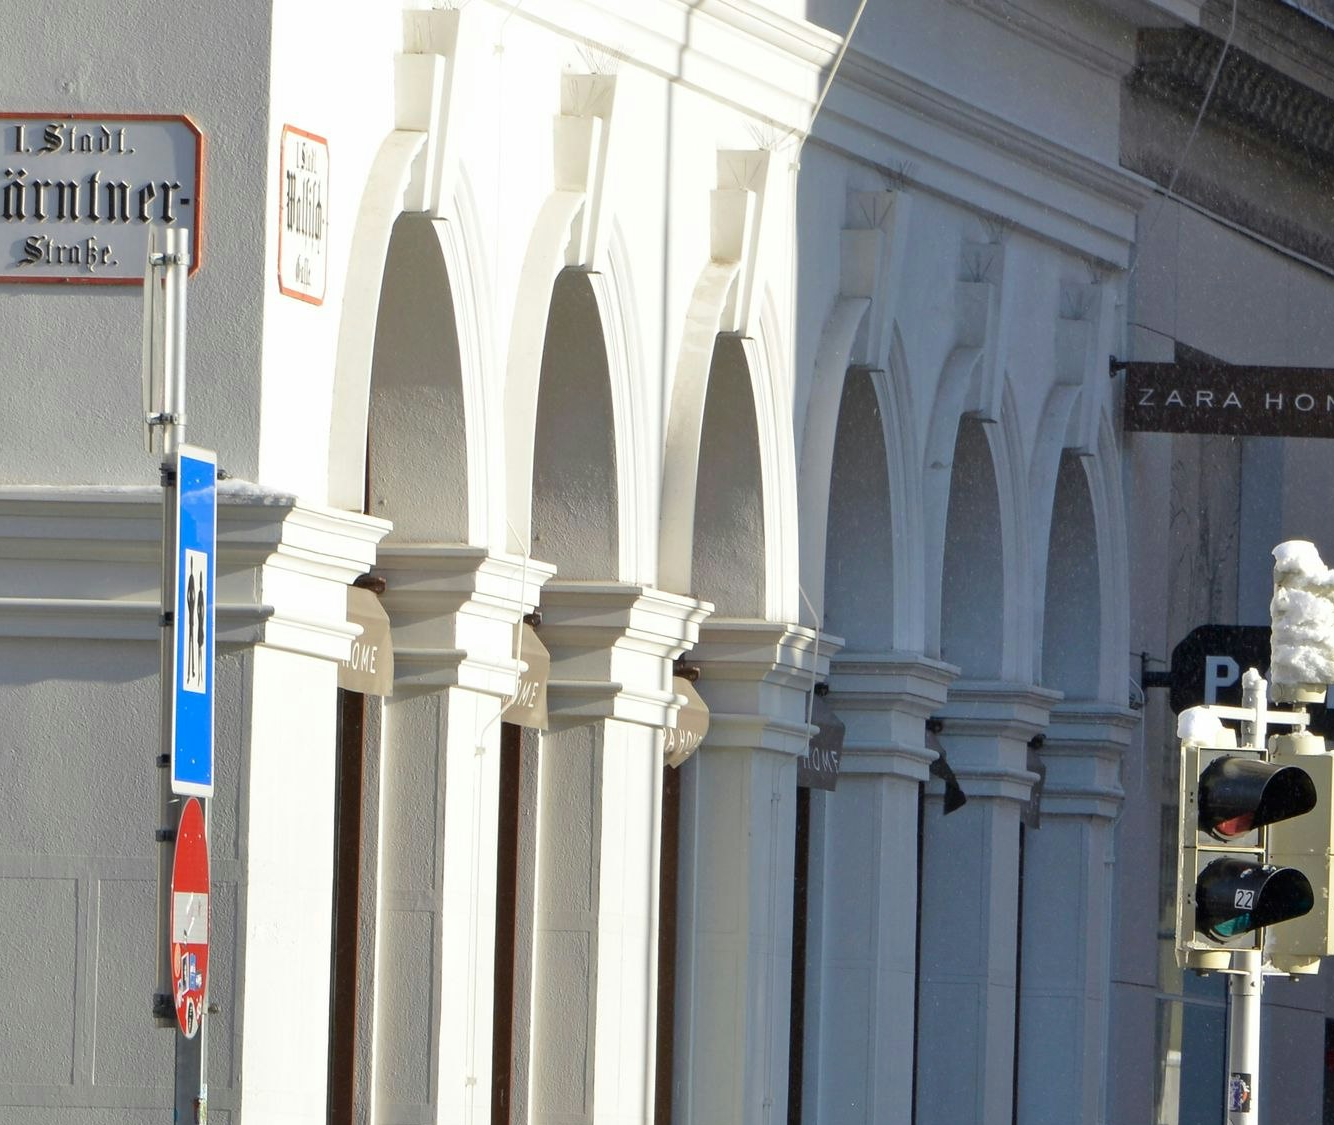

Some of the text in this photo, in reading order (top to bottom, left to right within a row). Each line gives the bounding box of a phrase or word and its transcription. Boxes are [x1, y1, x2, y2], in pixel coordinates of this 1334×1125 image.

[37, 122, 136, 156] Stadt.
[16, 233, 120, 273] Straße.
[1139, 388, 1242, 409] ZARA
[1236, 890, 1254, 909] 22
